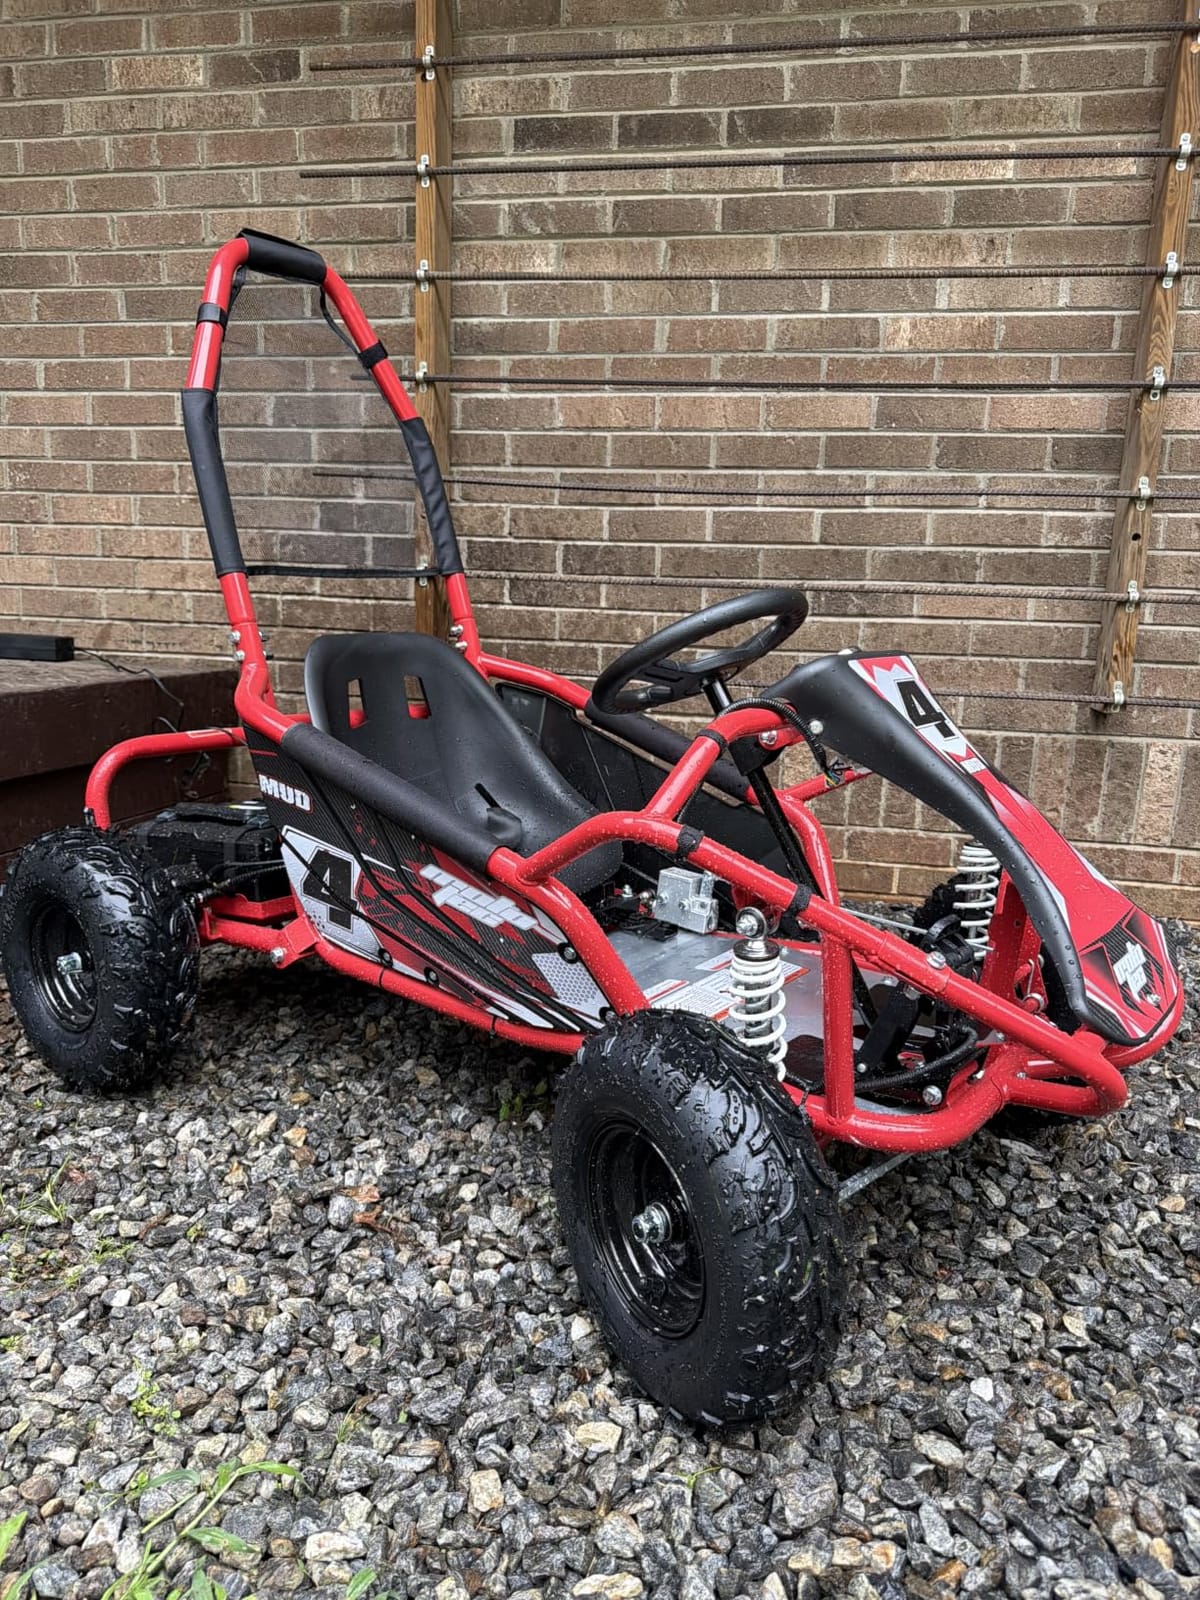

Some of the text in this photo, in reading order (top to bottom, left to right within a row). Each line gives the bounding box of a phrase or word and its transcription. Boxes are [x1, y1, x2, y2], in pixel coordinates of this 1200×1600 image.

[896, 681, 956, 739] 4
[258, 773, 311, 812] MUD
[302, 849, 359, 931] 4
